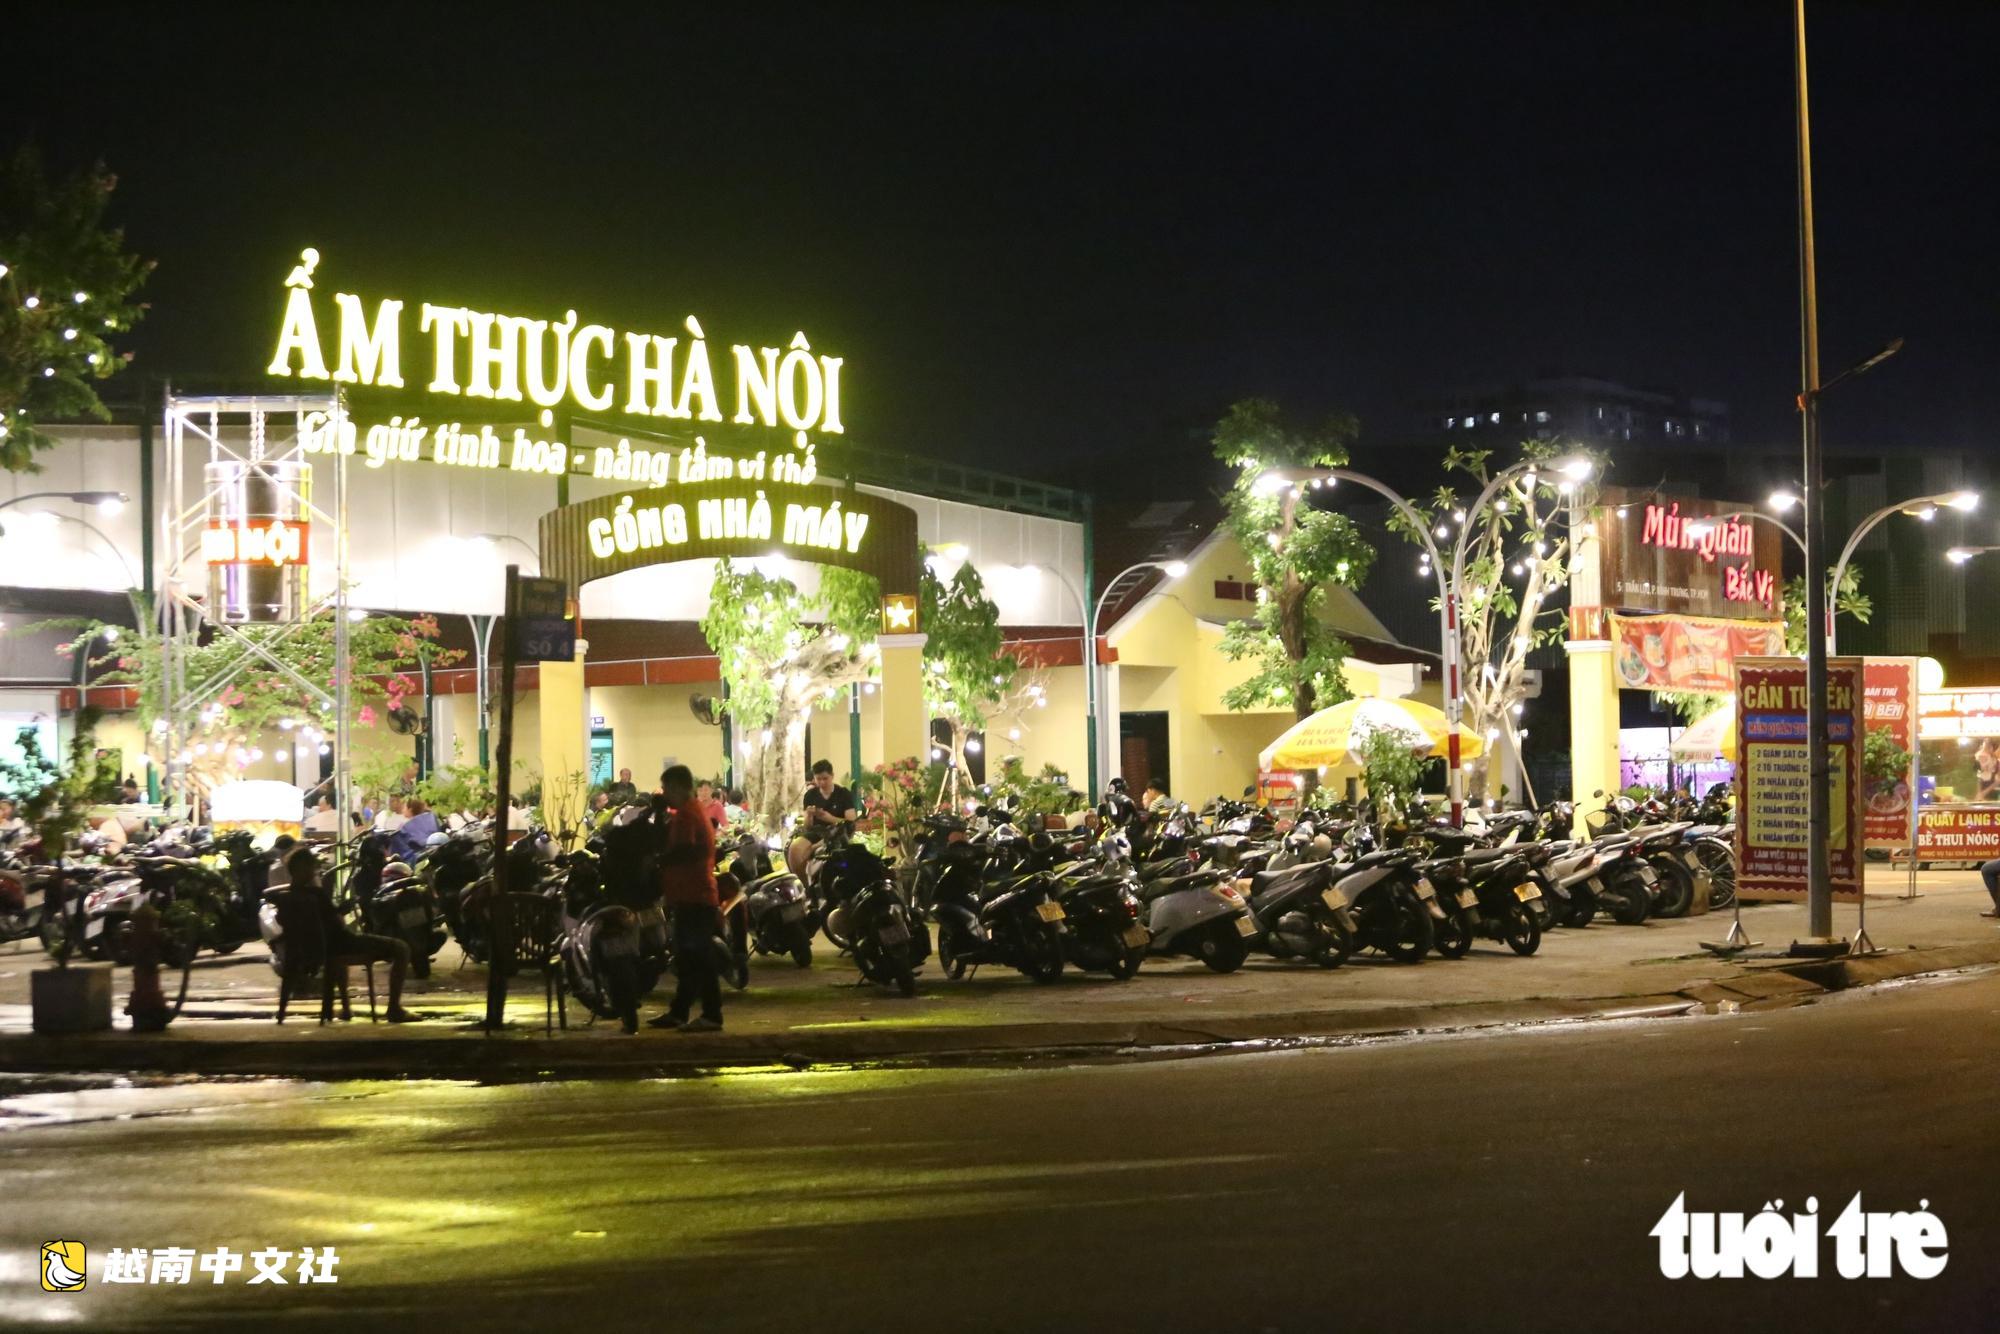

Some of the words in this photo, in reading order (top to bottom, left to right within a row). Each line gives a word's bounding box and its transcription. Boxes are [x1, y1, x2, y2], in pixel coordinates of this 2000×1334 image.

[267, 248, 405, 388] ẨM
[420, 302, 615, 428] THỰC
[624, 315, 723, 422] HÀ
[732, 330, 845, 450] NỘI
[511, 429, 567, 475] hoa
[593, 438, 671, 489] nâng
[588, 495, 688, 559] CỔNG
[697, 490, 772, 540] NHÀ
[782, 501, 869, 552] MÁY
[1726, 561, 1754, 601] Bắc
[1744, 678, 1784, 710] CẦN
[1935, 833, 1964, 847] THUI
[1966, 831, 1999, 847] NÓNG
[1959, 813, 1990, 829] LẠNG
